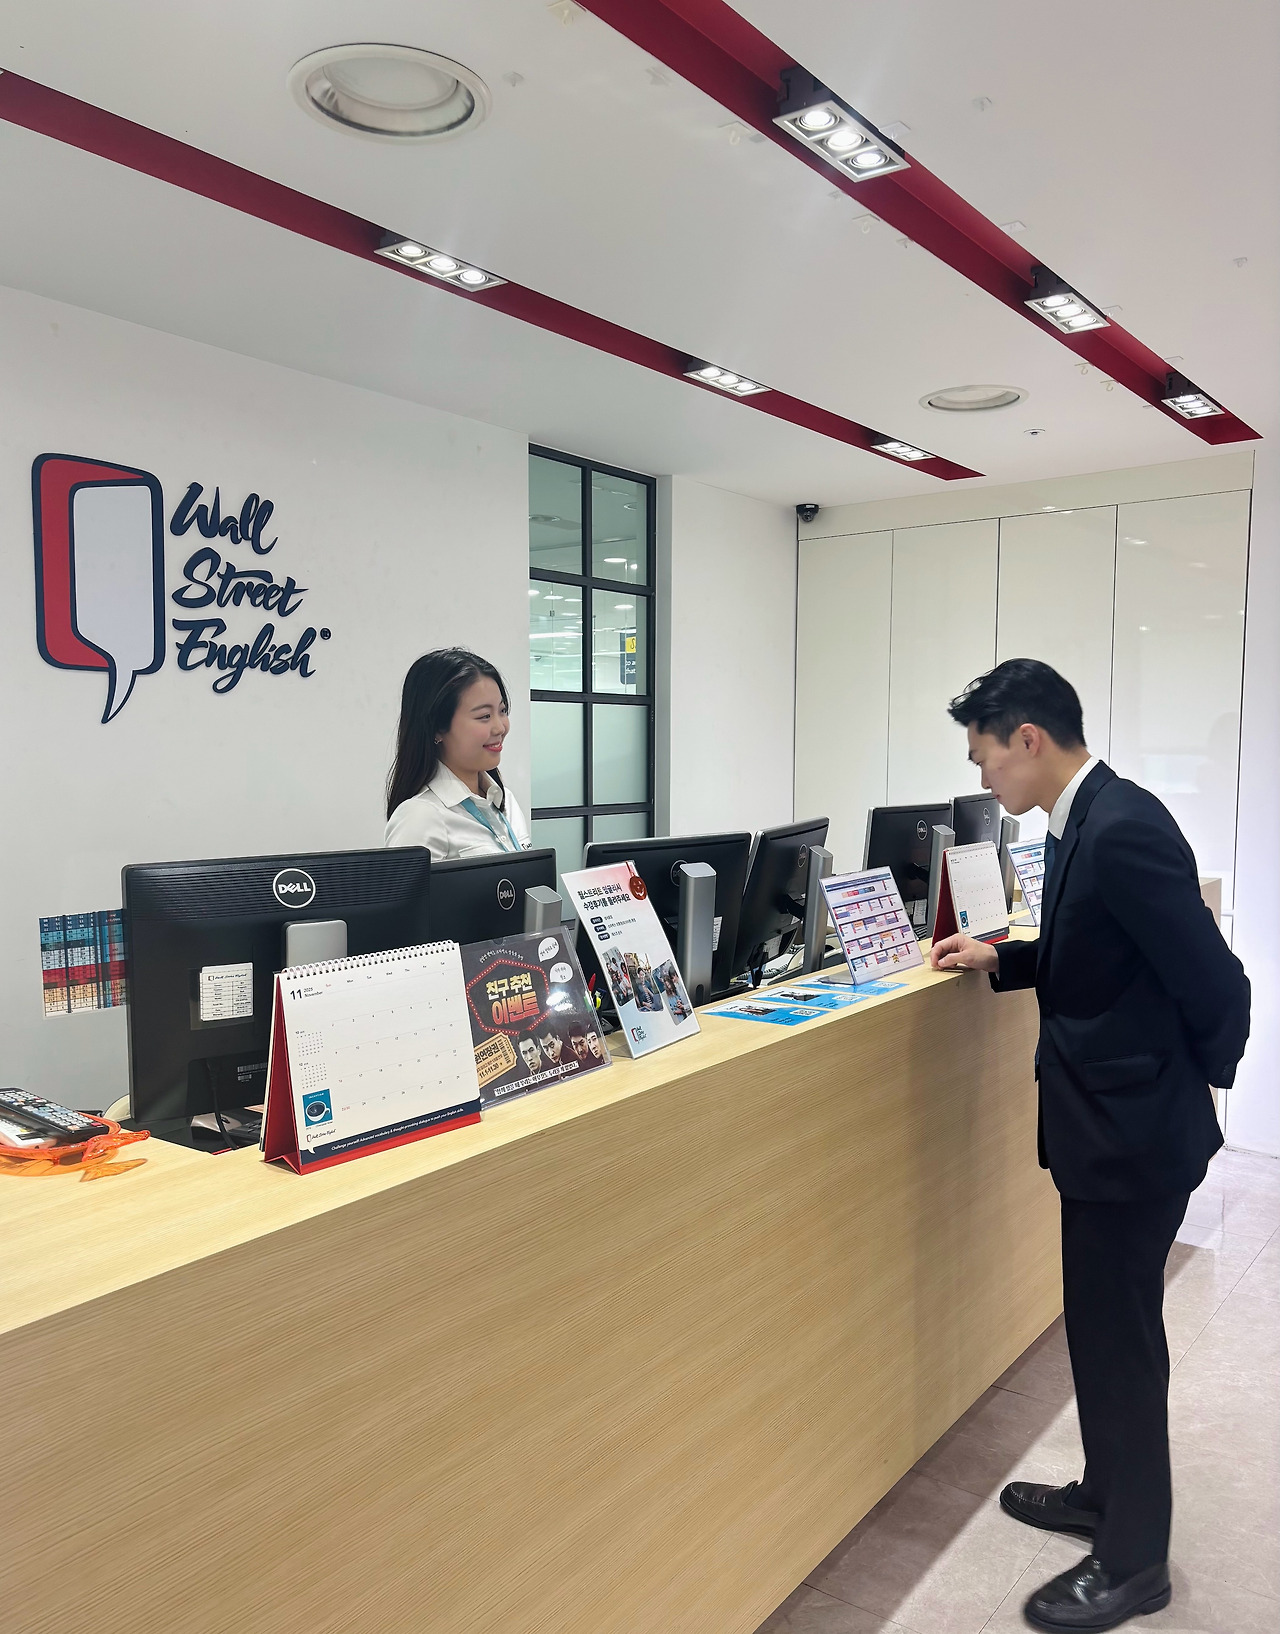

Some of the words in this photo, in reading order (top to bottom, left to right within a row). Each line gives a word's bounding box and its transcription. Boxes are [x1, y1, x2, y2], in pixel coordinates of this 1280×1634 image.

[170, 482, 278, 555] Wall
[172, 547, 309, 617] Street
[278, 882, 311, 894] DELL
[499, 889, 514, 900] DELL
[289, 988, 303, 1001] 11
[486, 978, 510, 1000] 친구
[510, 972, 533, 993] 추천
[491, 991, 540, 1025] 이벤트
